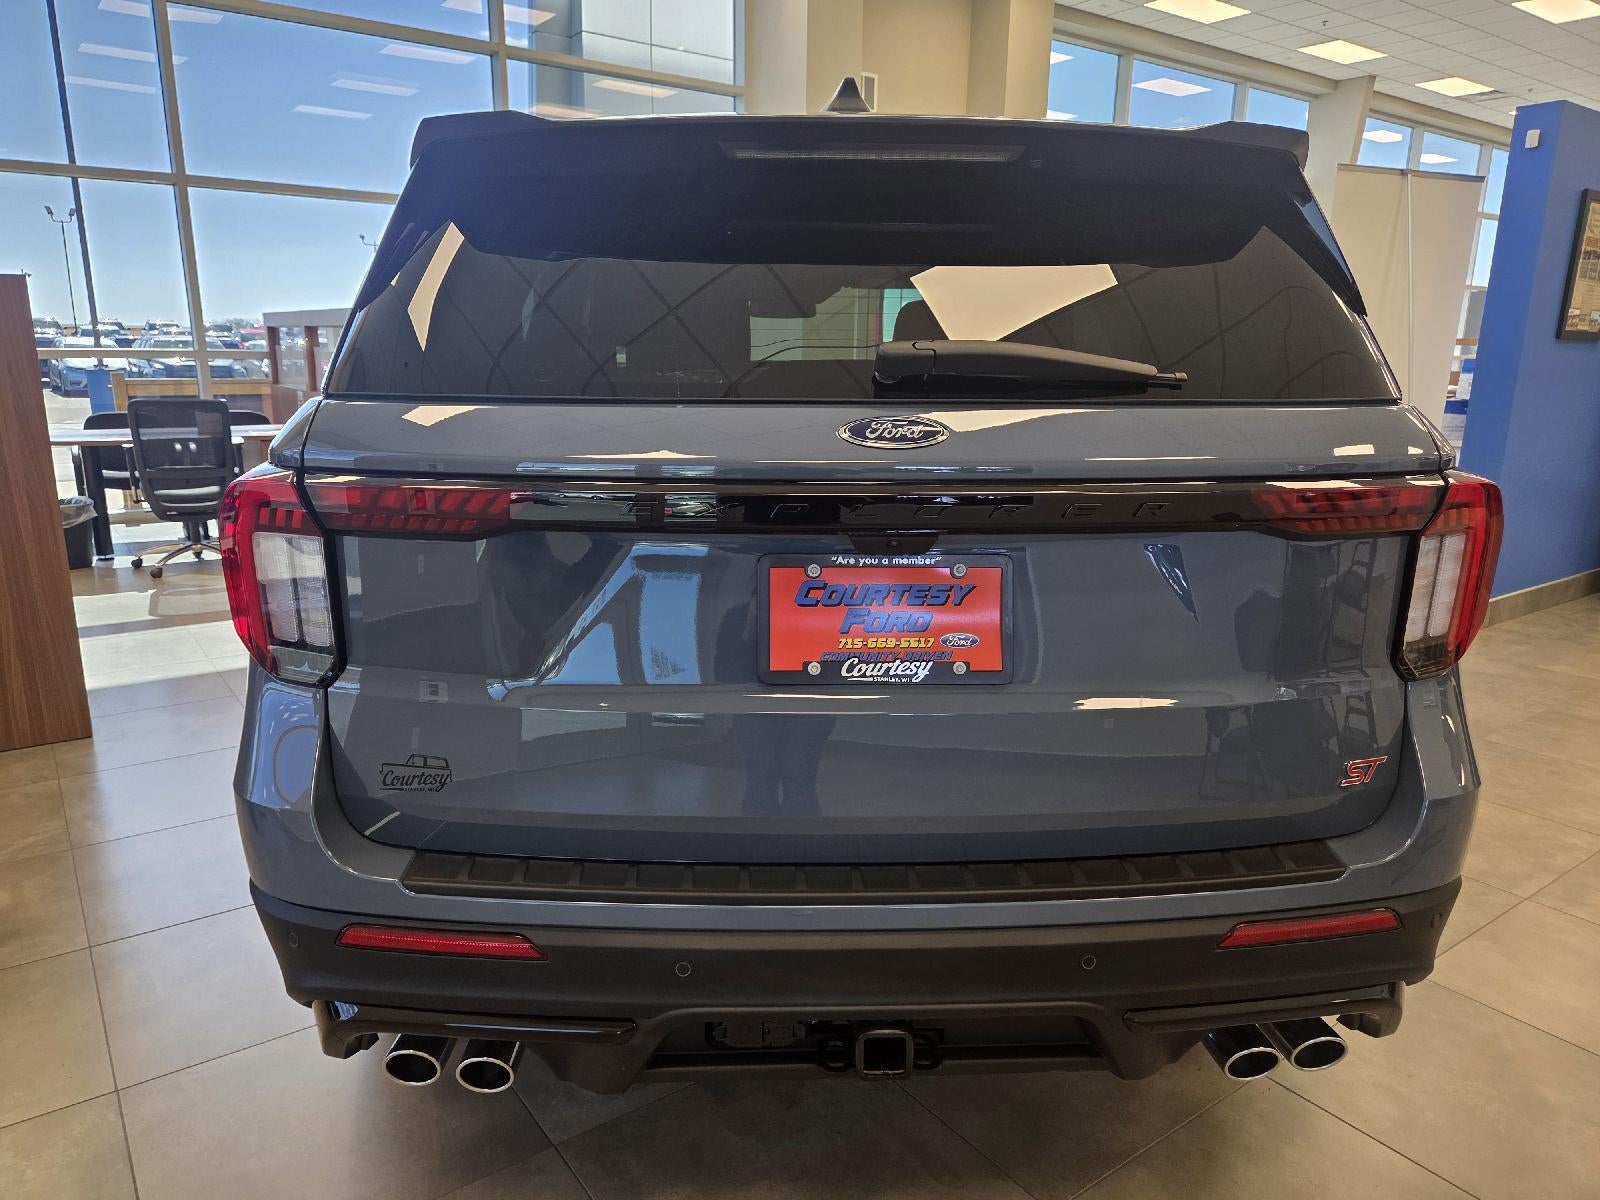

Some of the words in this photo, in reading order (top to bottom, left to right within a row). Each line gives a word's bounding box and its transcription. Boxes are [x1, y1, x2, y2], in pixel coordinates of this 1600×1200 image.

[866, 420, 941, 438] Ford
[623, 501, 1171, 519] EXPLORER
[859, 557, 879, 567] you
[881, 557, 889, 565] a
[903, 651, 953, 661] DRIVEN
[841, 657, 934, 683] Courtesy
[1340, 755, 1388, 786] ST
[382, 770, 449, 792] Courtesy
